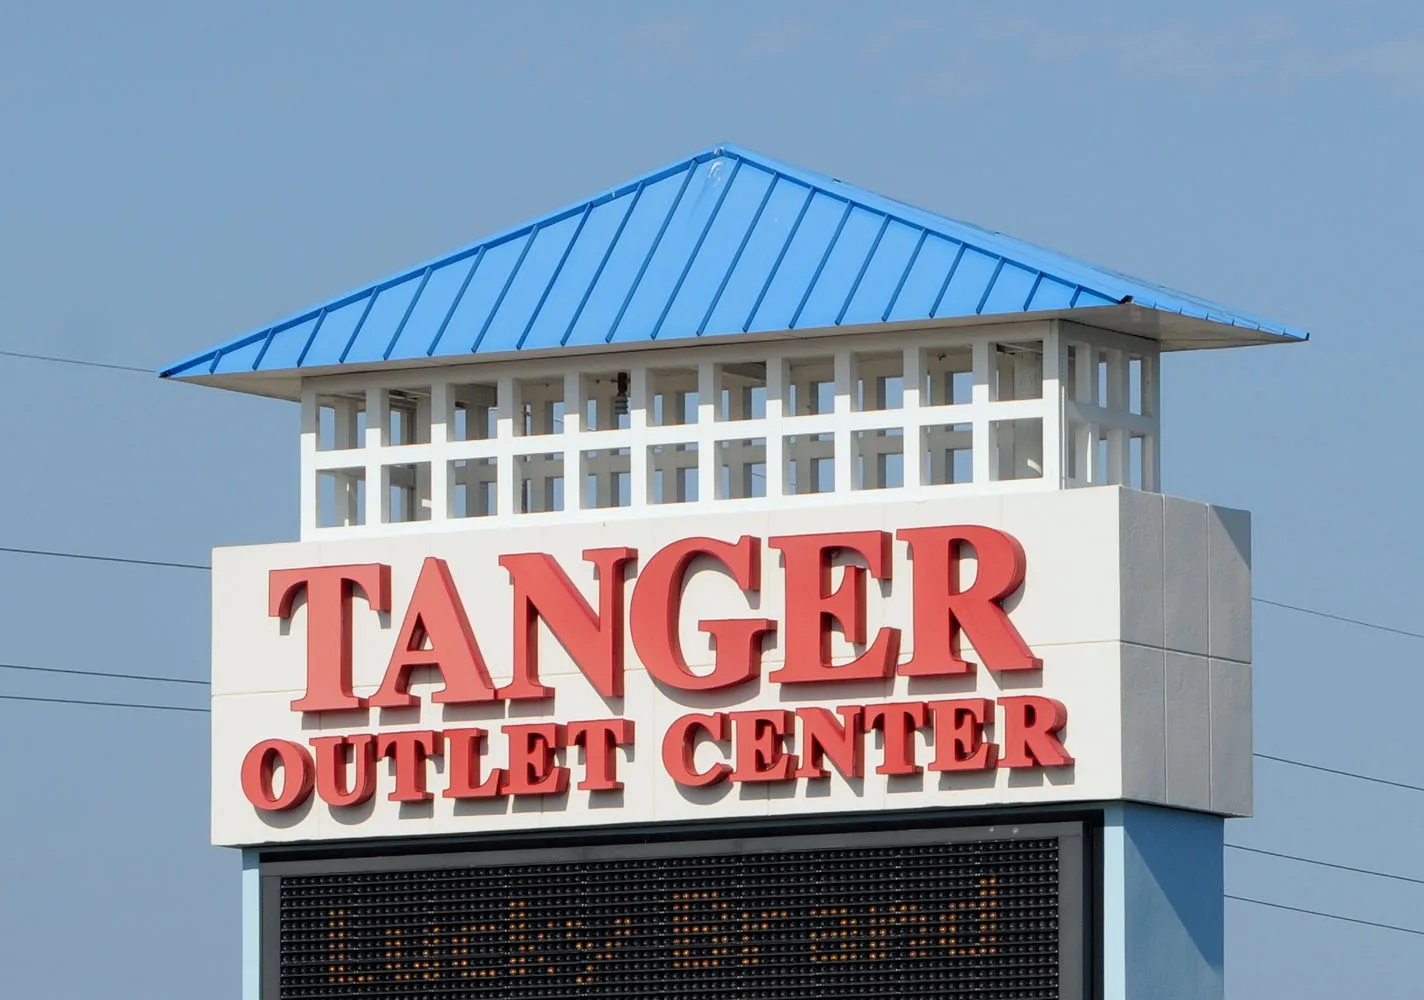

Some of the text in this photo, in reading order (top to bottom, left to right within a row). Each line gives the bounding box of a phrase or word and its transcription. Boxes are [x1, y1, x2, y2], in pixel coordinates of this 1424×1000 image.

[268, 525, 1045, 713] TANGER
[241, 695, 1074, 811] OUTLET CENTER
[328, 877, 997, 984] Lucky Brand
